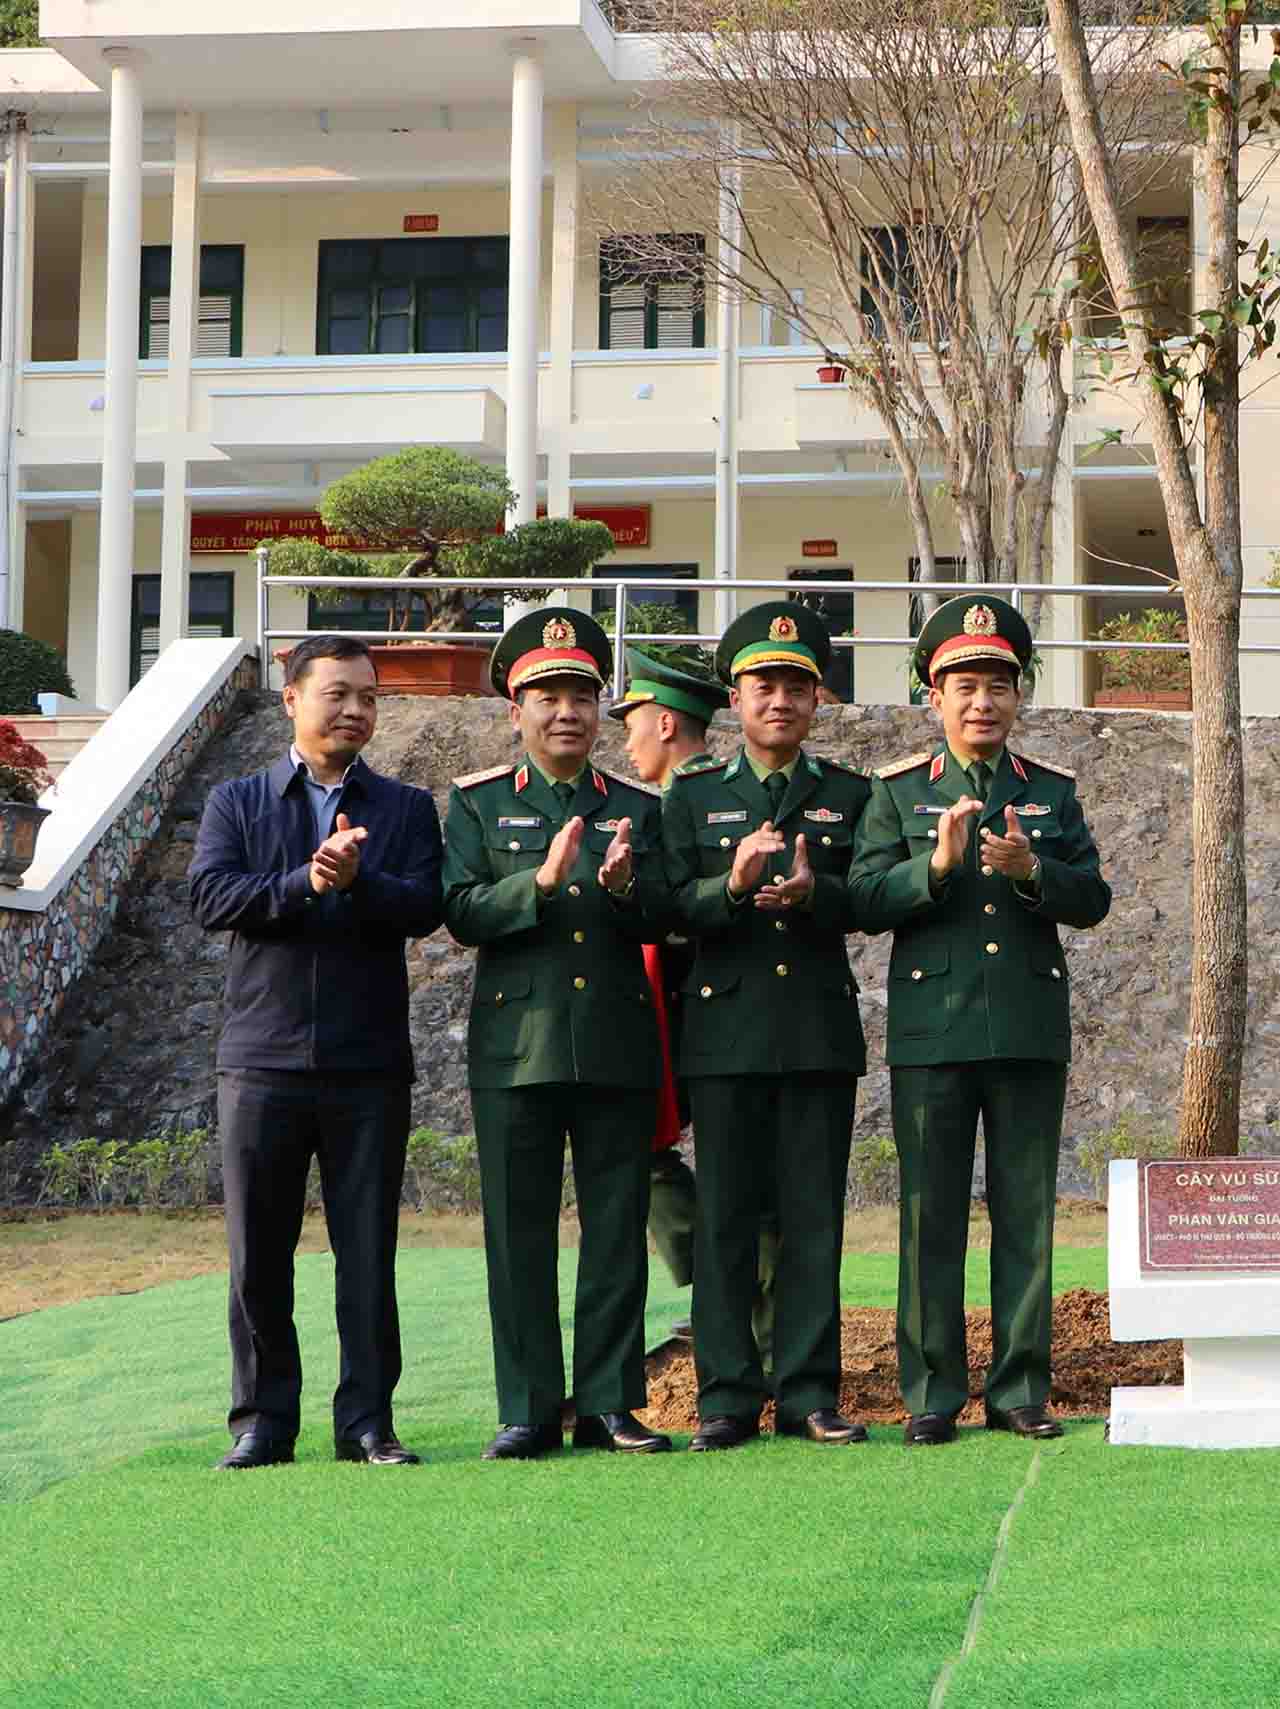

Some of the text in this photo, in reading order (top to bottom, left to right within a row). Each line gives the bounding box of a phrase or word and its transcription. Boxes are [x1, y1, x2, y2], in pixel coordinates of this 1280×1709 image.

[289, 519, 317, 530] HUY
[1176, 1170, 1214, 1186] CÂY
[1168, 1214, 1212, 1225] PHAN
